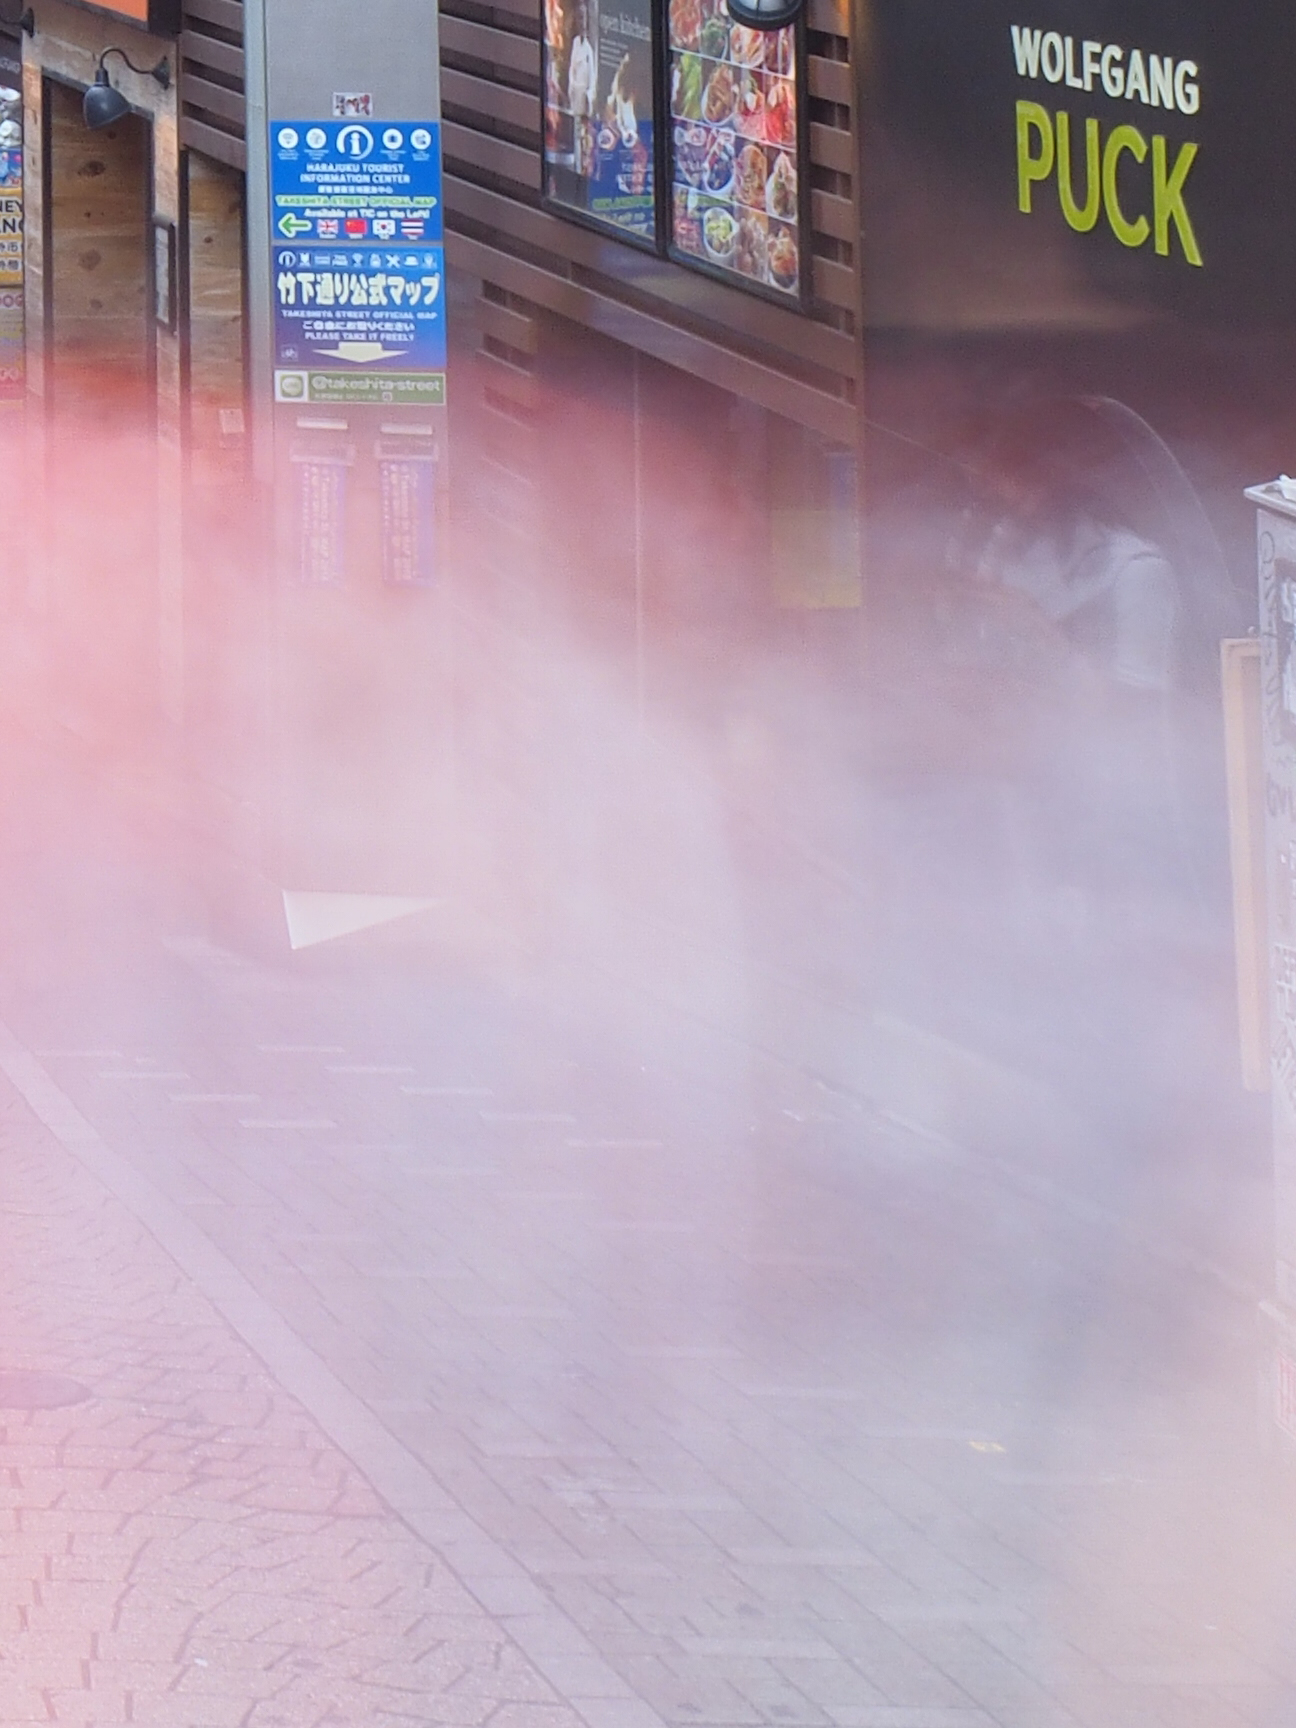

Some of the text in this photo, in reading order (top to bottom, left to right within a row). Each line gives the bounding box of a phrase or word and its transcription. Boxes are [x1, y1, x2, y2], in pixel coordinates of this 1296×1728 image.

[1010, 23, 1200, 116] WOLFGANG
[1014, 99, 1204, 267] PUCK
[276, 271, 441, 306] 竹下通り公式マップ
